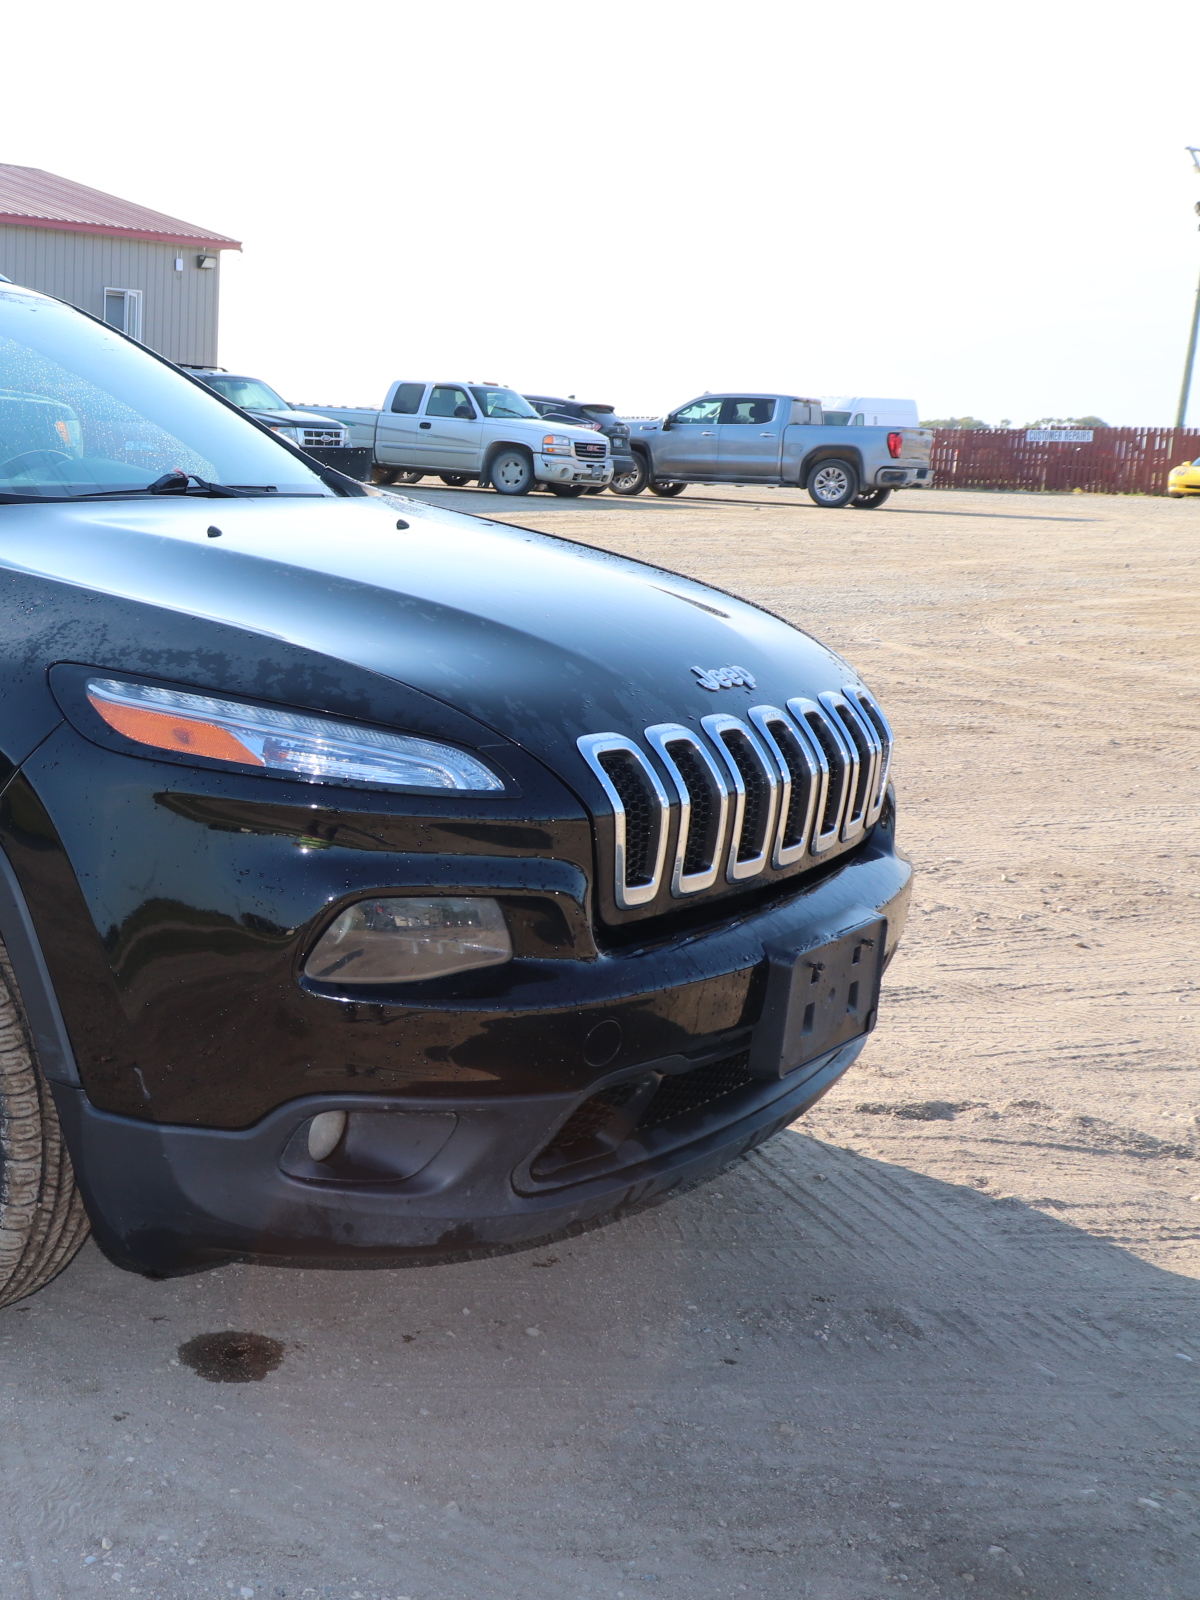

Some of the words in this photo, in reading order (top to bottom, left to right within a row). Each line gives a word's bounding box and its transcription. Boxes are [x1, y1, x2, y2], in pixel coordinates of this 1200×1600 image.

[1029, 430, 1062, 441] CUSTOMER
[1064, 430, 1091, 441] REPAIRS
[690, 665, 757, 691] Jeep
